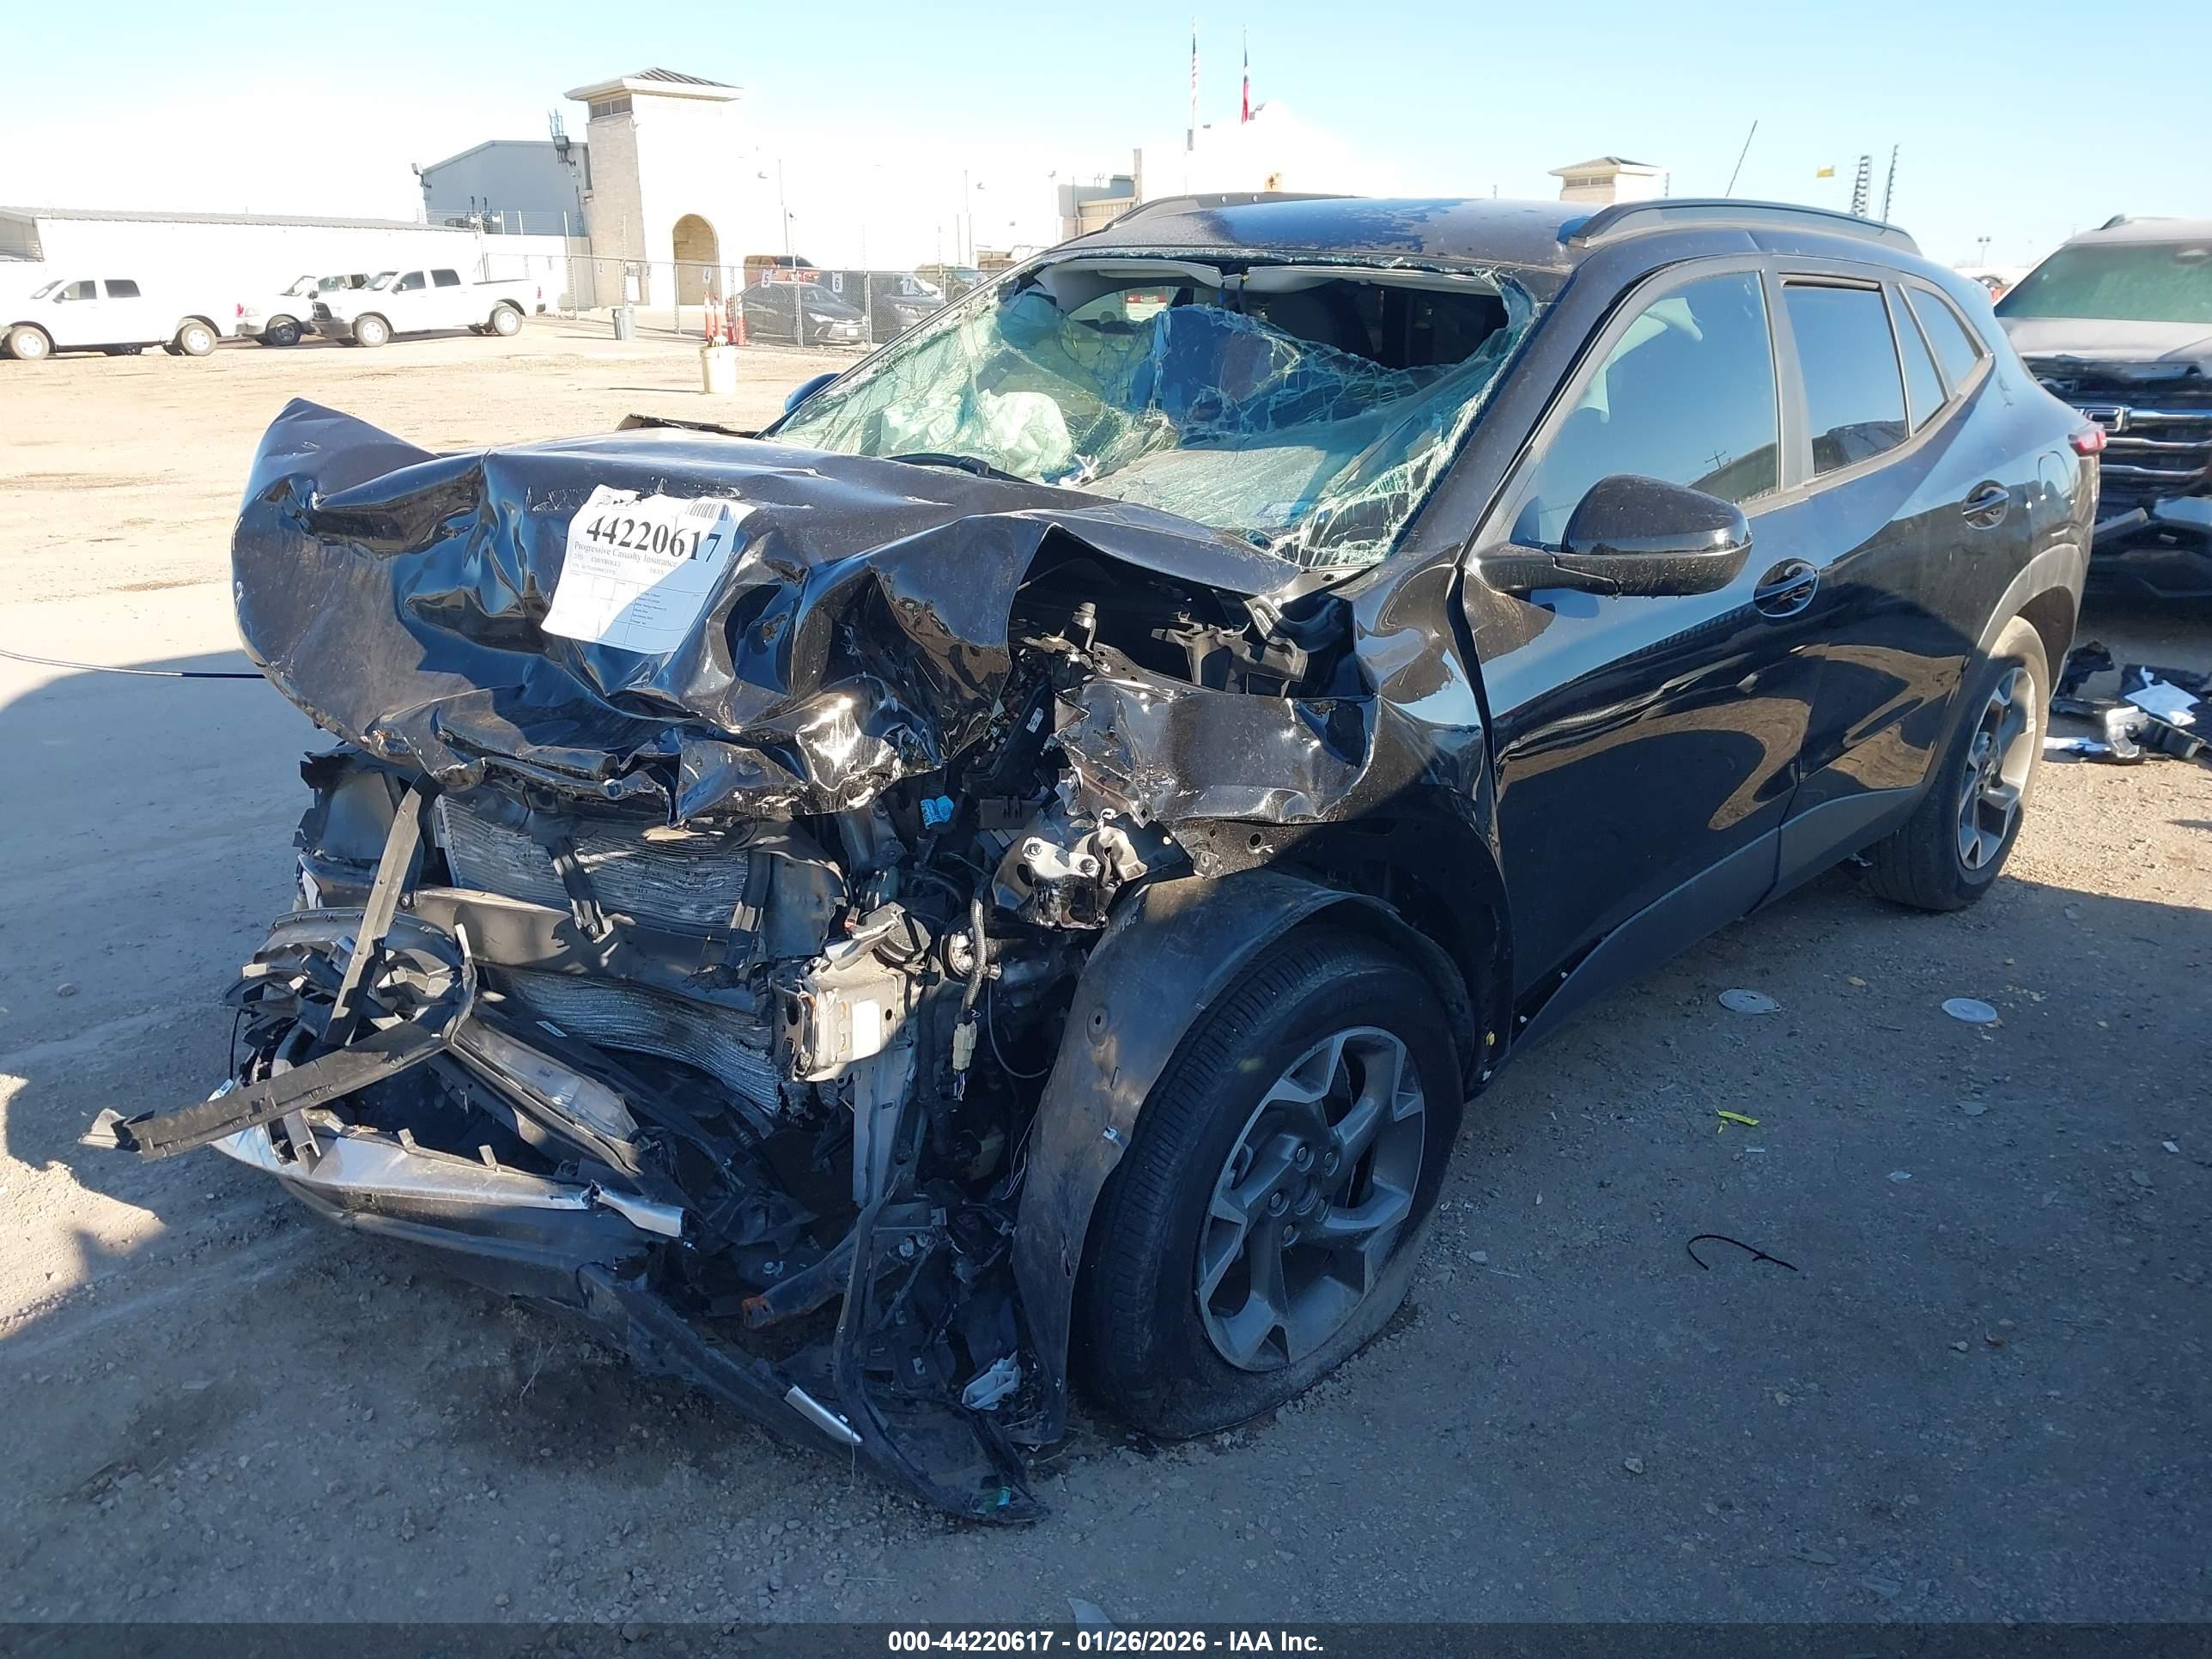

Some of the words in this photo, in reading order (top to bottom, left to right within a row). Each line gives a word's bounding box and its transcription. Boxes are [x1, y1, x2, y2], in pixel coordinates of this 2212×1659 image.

[763, 274, 769, 285] 5
[834, 277, 840, 289] 6
[905, 278, 911, 291] 7
[586, 515, 722, 562] 44220617
[574, 541, 611, 556] Progressive
[612, 548, 641, 562] Casualty
[643, 554, 678, 568] Insurance
[591, 556, 621, 568] CHEVROLET
